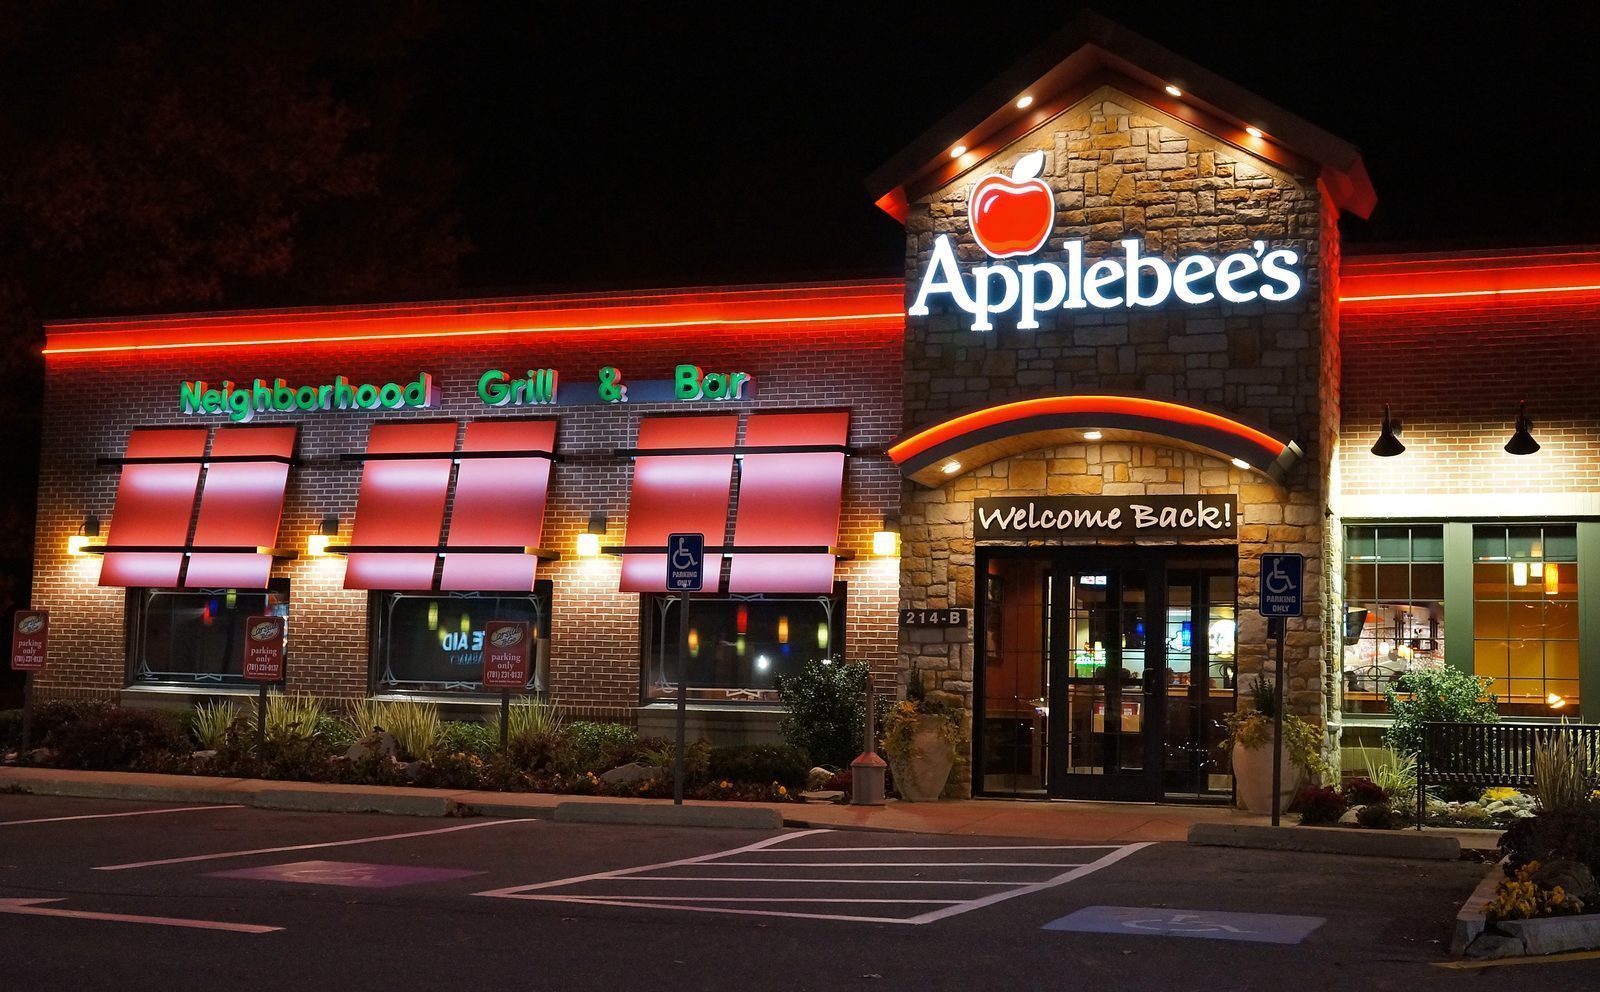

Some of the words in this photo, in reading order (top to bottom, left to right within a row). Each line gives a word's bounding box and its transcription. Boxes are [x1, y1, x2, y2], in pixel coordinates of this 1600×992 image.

[908, 233, 1301, 331] Applebee's
[179, 371, 431, 422] Neighborhood
[477, 367, 559, 406] Grill
[599, 364, 628, 403] &
[674, 364, 751, 401] Bar
[977, 502, 1122, 530] Welcome
[1129, 500, 1232, 529] Back!
[1266, 595, 1296, 603] PARKING
[906, 611, 961, 625] 214-B
[18, 639, 42, 649] parking
[22, 648, 37, 656] only
[251, 646, 278, 656] parking
[256, 655, 271, 664] only
[491, 653, 521, 662] parking
[497, 662, 514, 671] only
